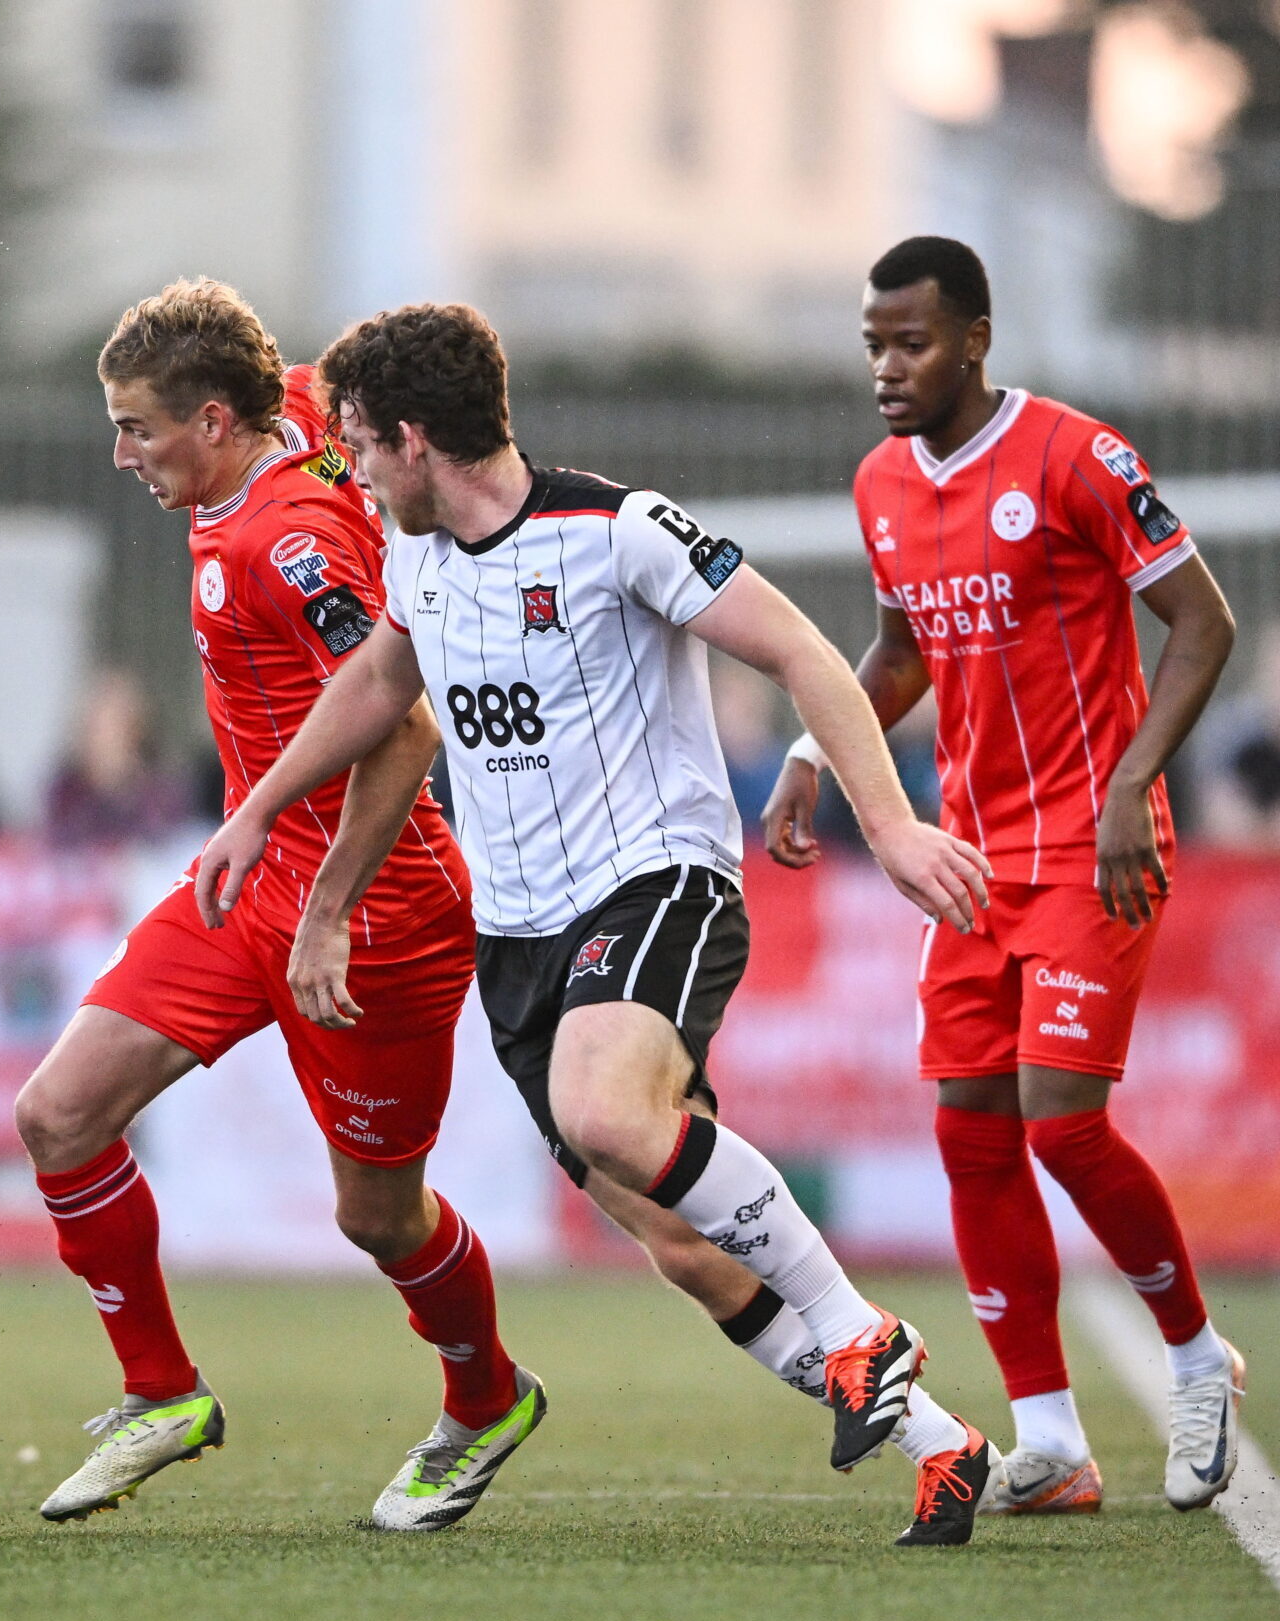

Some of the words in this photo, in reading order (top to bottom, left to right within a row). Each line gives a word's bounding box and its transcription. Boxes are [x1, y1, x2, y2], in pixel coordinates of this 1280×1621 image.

[280, 552, 328, 584] Protein
[704, 552, 726, 578] LEAGUE
[709, 551, 740, 587] IRELAND
[297, 571, 328, 596] Milk
[324, 596, 341, 610] sse
[323, 625, 348, 645] LEAGUE
[329, 629, 362, 655] IRELAND
[446, 681, 546, 750] 888
[485, 752, 551, 774] casino
[1035, 967, 1110, 998] Culligan
[323, 1077, 401, 1113] Culligan
